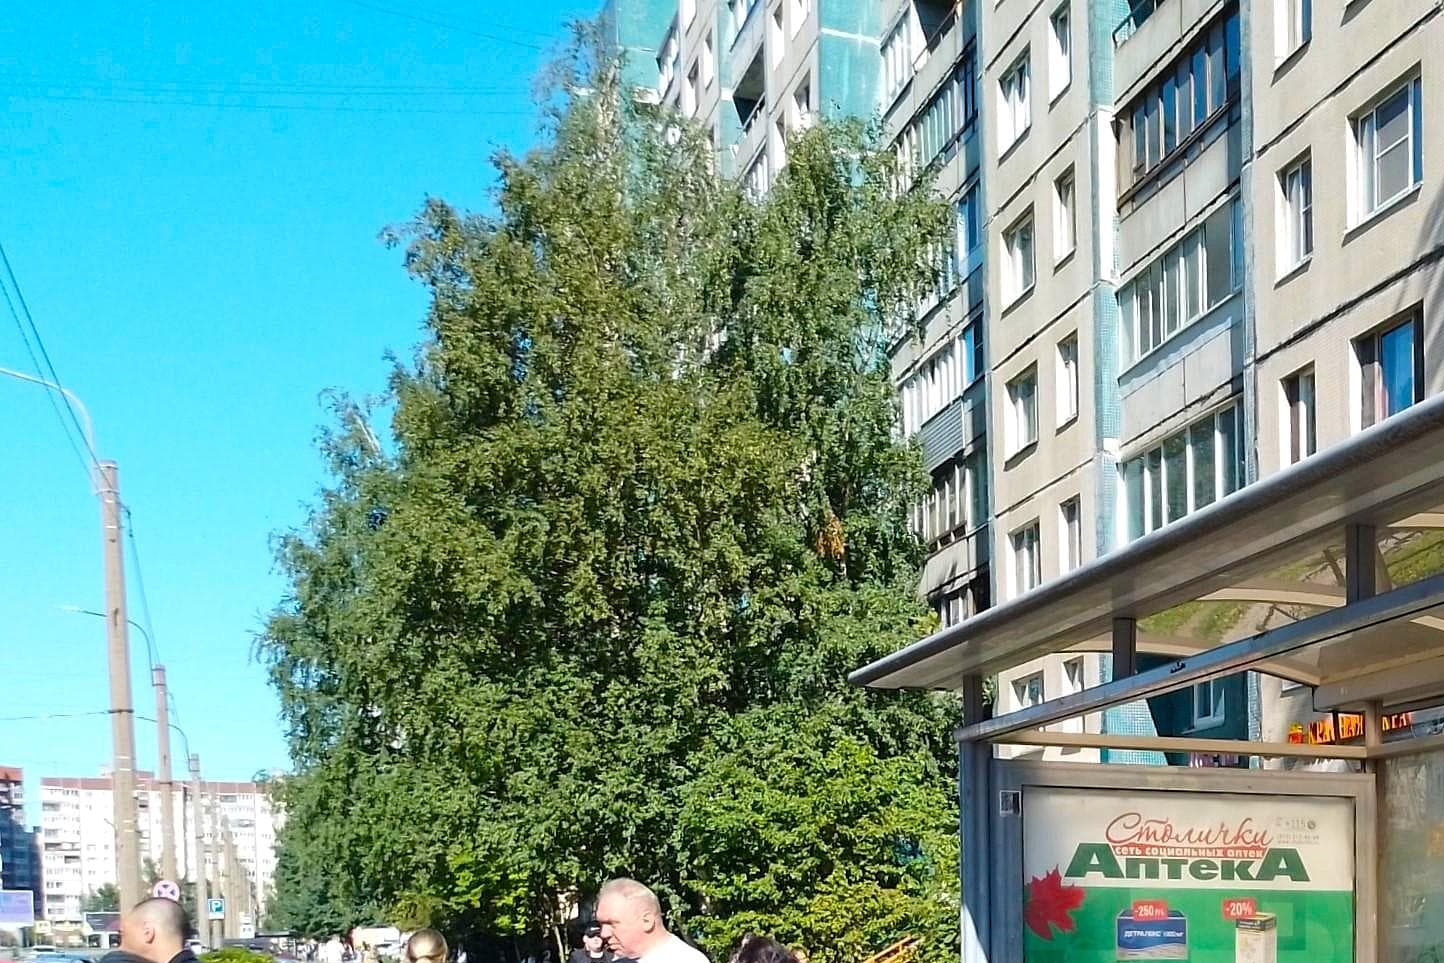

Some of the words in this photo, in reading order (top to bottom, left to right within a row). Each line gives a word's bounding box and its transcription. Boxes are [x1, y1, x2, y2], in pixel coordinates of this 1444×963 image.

[1106, 812, 1273, 846] Столички
[1115, 845, 1142, 856] сеть
[1145, 847, 1225, 858] социальных
[1226, 849, 1263, 858] аптек
[1134, 904, 1154, 917] -250
[1225, 902, 1253, 916] -20%
